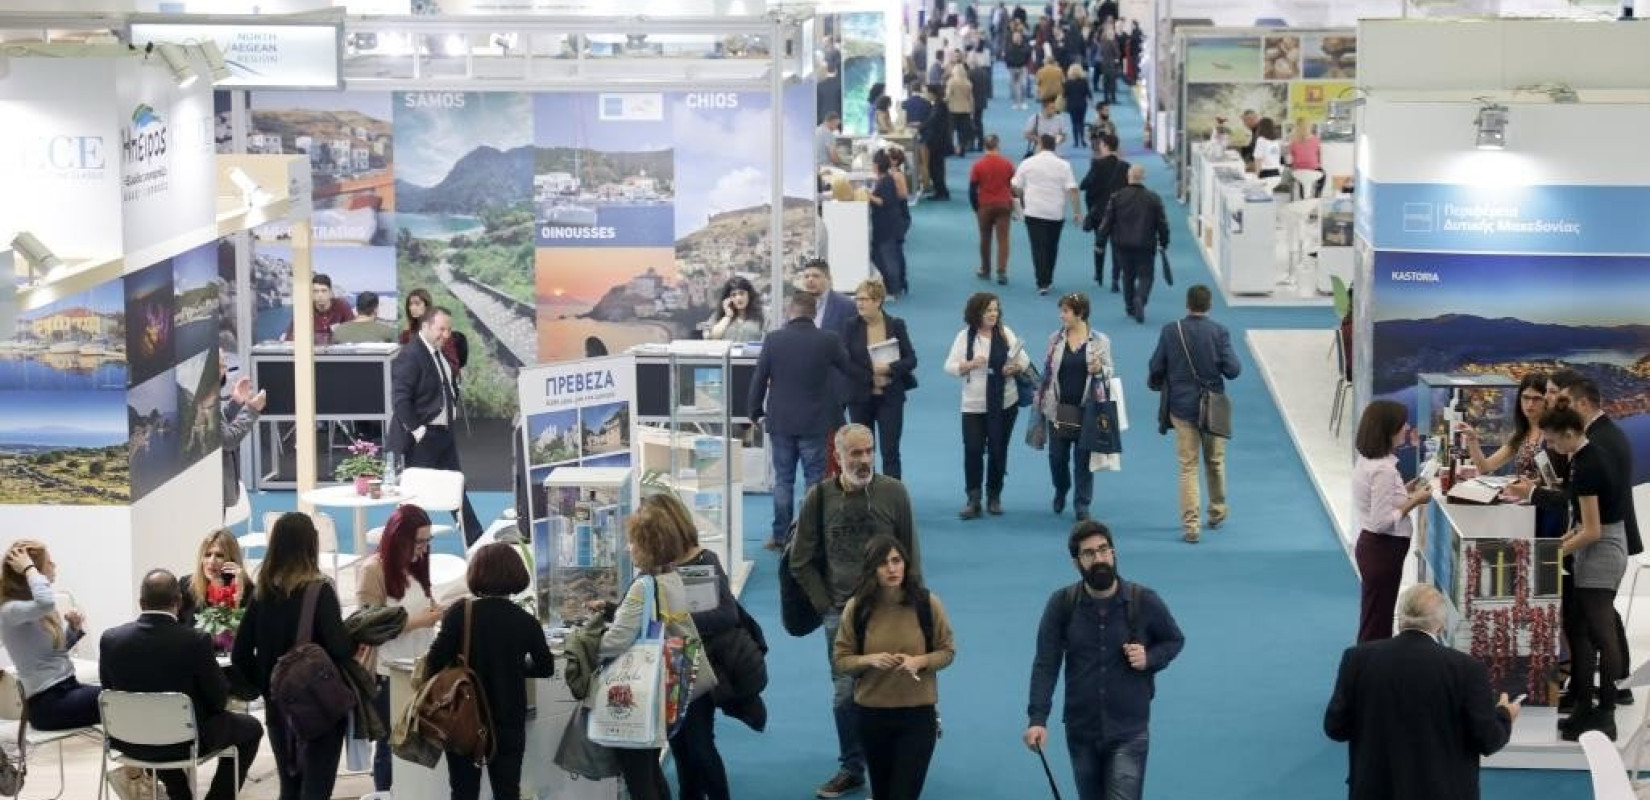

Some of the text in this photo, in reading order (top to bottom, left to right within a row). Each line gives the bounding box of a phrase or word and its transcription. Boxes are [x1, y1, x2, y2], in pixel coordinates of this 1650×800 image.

[231, 43, 278, 53] AEGEAN
[405, 92, 464, 108] SAMOS
[686, 92, 738, 108] CHIOS
[541, 226, 616, 239] OINOUSSES
[1391, 271, 1439, 283] KASTORIA
[545, 370, 614, 396] ΠΡΕΒΕΖΑ
